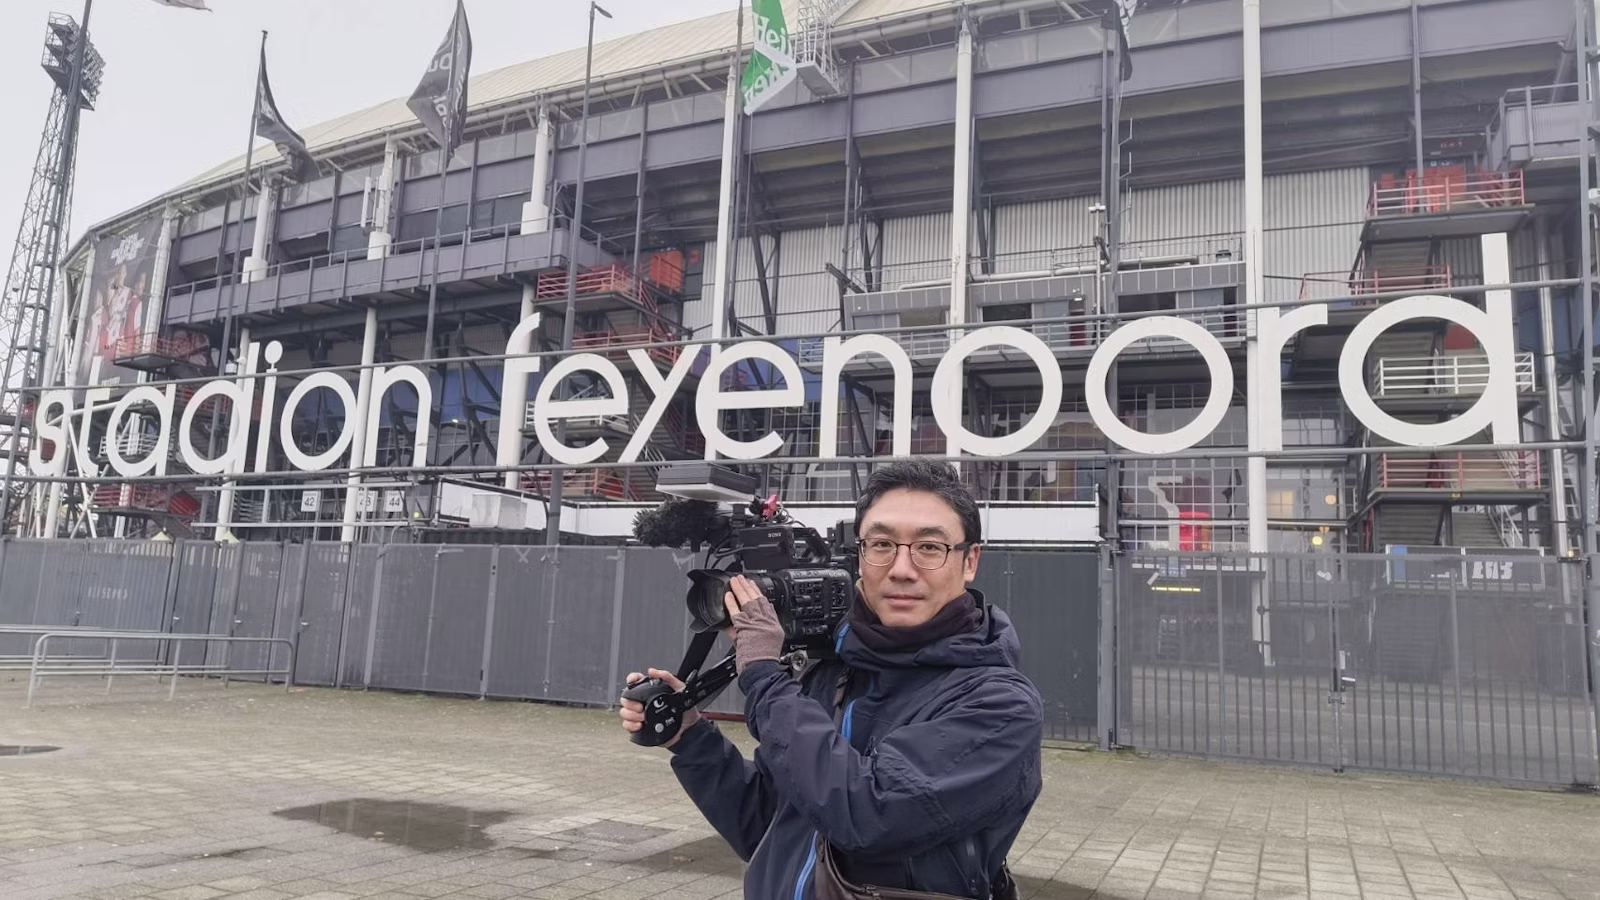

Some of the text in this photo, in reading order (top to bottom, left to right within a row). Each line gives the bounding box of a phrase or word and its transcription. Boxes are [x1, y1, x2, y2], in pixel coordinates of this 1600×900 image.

[29, 233, 1520, 478] stadion feyenoord
[304, 496, 315, 507] 42
[389, 497, 400, 507] 44
